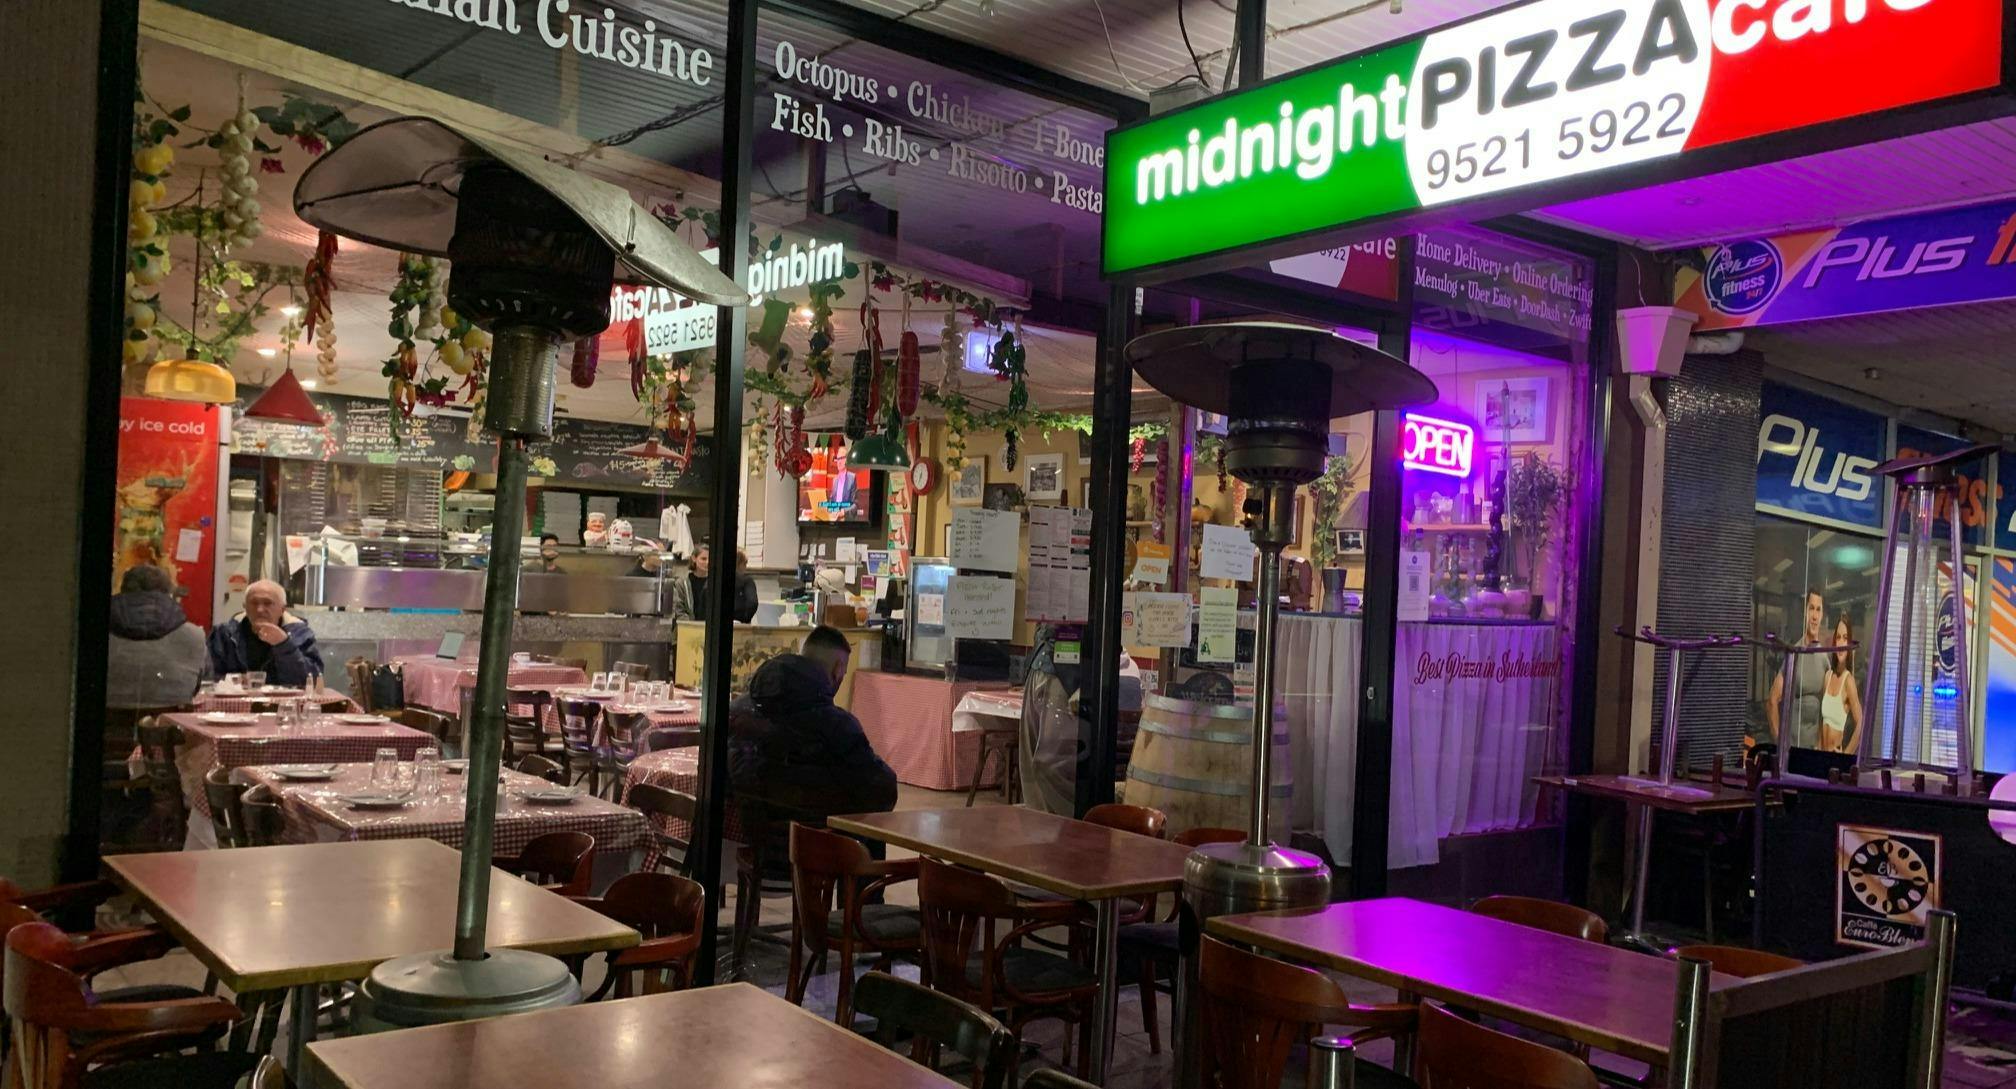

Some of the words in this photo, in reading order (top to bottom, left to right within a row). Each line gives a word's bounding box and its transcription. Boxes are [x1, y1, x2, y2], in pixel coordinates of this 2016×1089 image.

[536, 0, 713, 86] Cuisine
[1420, 0, 1699, 131] PIZZA
[775, 40, 878, 103] Octopus
[907, 81, 1003, 138] Chicken
[1033, 117, 1105, 169] T-Bone
[1136, 73, 1407, 206] midnight
[1426, 129, 1531, 191] 9521
[1556, 92, 1687, 160] 5922
[771, 92, 833, 144] Fish
[862, 118, 921, 167] Ribs
[948, 143, 1027, 194] Risotto
[1050, 170, 1103, 214] Pasta
[1415, 267, 1459, 298] Menulog
[1467, 280, 1491, 304] Uber
[1491, 290, 1512, 309] Eats
[1519, 299, 1561, 324] DoorDash
[1416, 232, 1451, 264] Home
[1454, 243, 1502, 281] Delivery
[1512, 262, 1548, 291] Online
[1549, 273, 1594, 307] Ordering
[1721, 274, 1766, 298] fitness
[1802, 235, 1975, 289] Plus
[139, 416, 164, 432] ice
[168, 420, 205, 436] cold
[1404, 421, 1469, 469] OPEN
[1756, 413, 1879, 501] Plus
[1414, 650, 1444, 685] Best
[1446, 650, 1482, 684] Pizza
[1482, 654, 1495, 678] in
[1496, 649, 1560, 684] Sutherland
